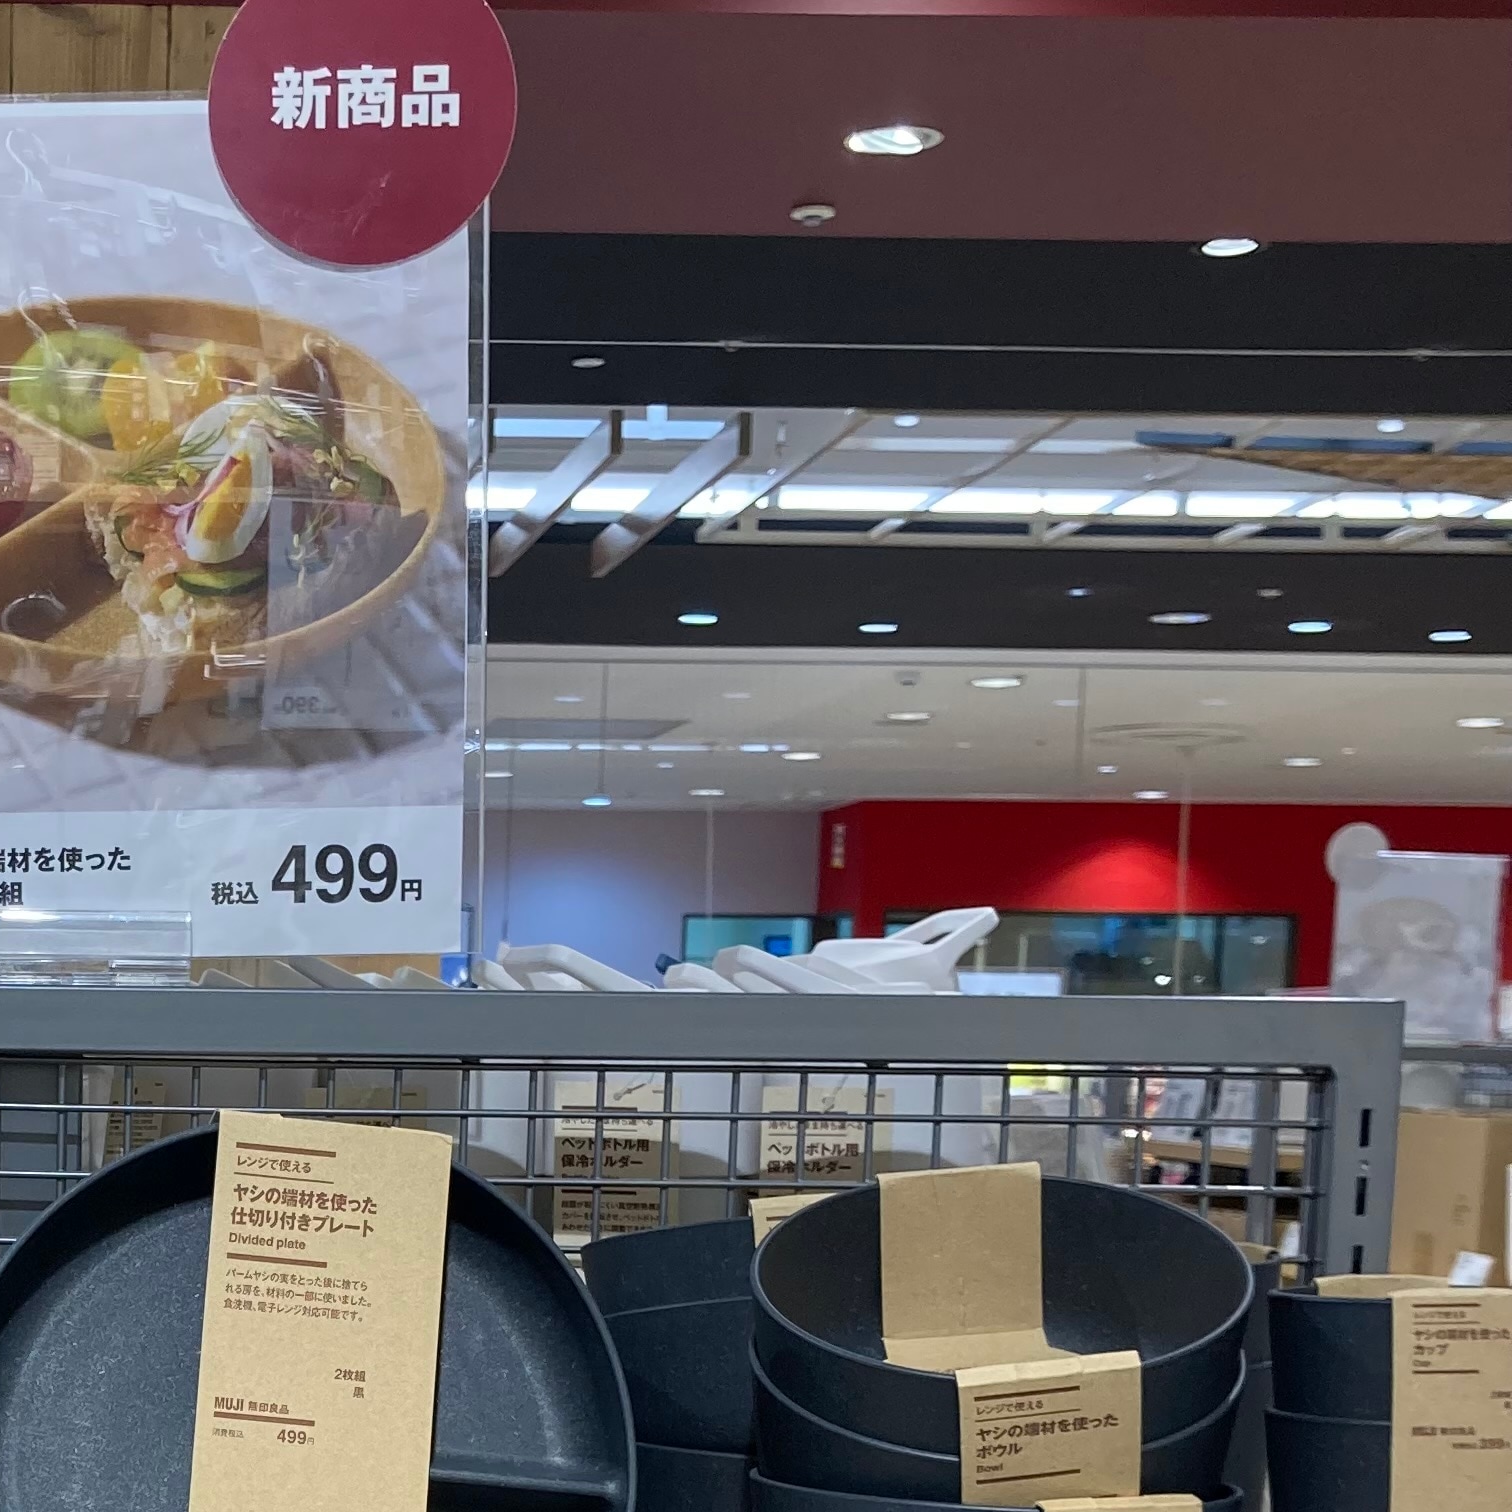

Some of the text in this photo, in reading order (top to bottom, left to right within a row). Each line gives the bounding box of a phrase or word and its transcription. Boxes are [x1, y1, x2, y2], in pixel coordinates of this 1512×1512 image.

[272, 65, 460, 129] 新商品
[210, 881, 259, 905] 税込
[768, 1142, 858, 1156] ペッボトル用
[237, 1156, 311, 1173] レンジで使える
[562, 1155, 643, 1168] 保冷ルダー
[233, 1184, 378, 1215] ヤシの端材を使った
[231, 1207, 374, 1237] 仕切り付きプレート
[229, 1233, 306, 1251] Divided plate
[334, 1369, 366, 1382] 2枚組
[214, 1396, 289, 1415] MUJI 無印良品
[976, 1400, 1043, 1415] レンジで使える
[976, 1414, 1119, 1442] ヤシの端材を使った
[976, 1443, 1023, 1459] ボウル
